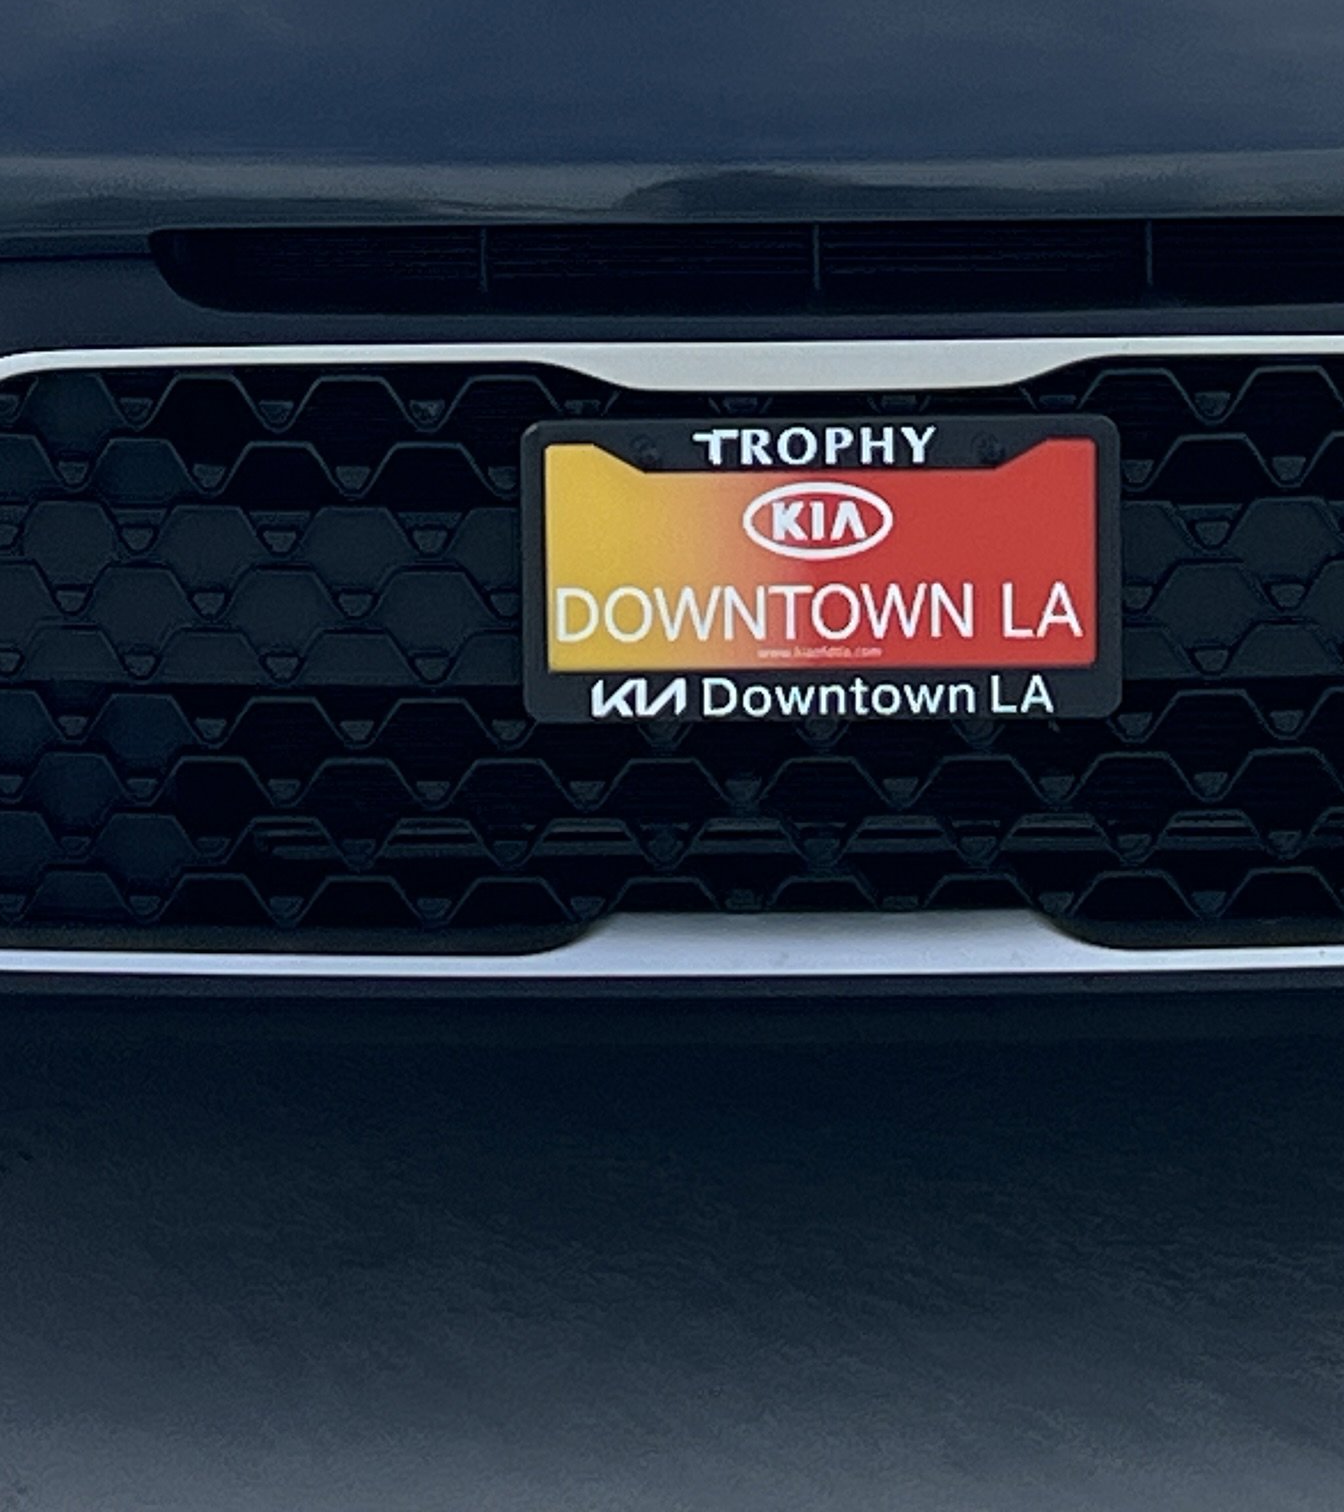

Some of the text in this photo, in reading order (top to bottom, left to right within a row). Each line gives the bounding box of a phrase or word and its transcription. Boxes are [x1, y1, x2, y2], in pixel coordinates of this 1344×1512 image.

[692, 424, 937, 467] TROPHY
[771, 499, 868, 542] KIA
[556, 581, 1084, 644] DOWNTOWN LA
[590, 675, 1055, 719] KIA Downtown LA
